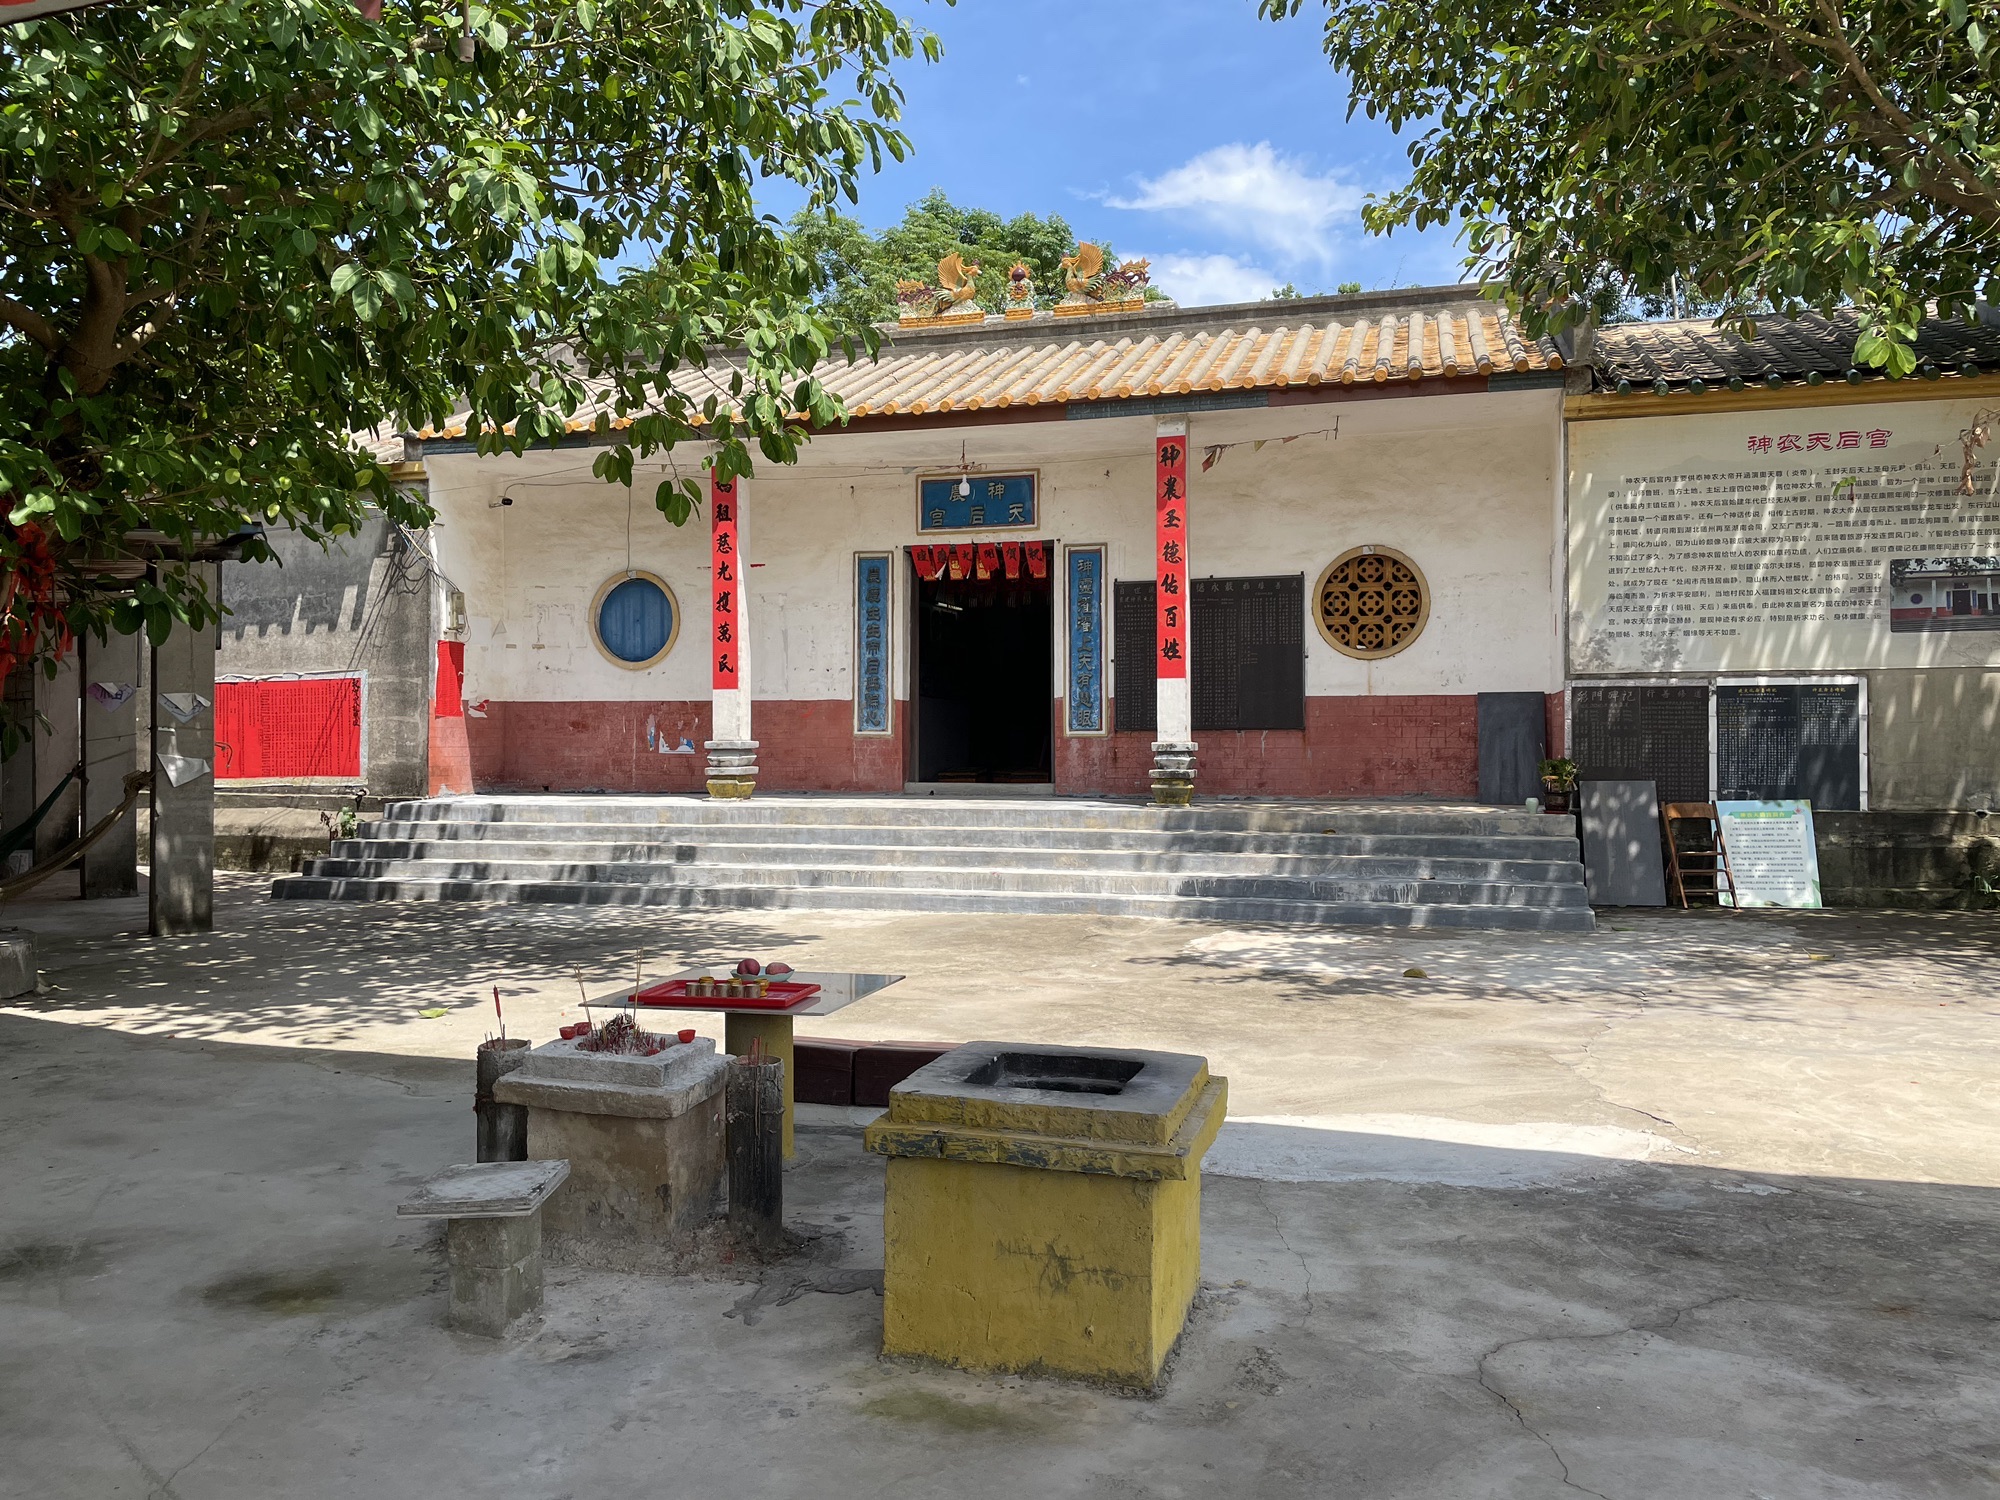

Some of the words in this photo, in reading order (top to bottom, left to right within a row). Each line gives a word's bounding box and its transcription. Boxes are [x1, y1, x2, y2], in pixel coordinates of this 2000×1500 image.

[1747, 428, 1894, 455] 神农天后宫
